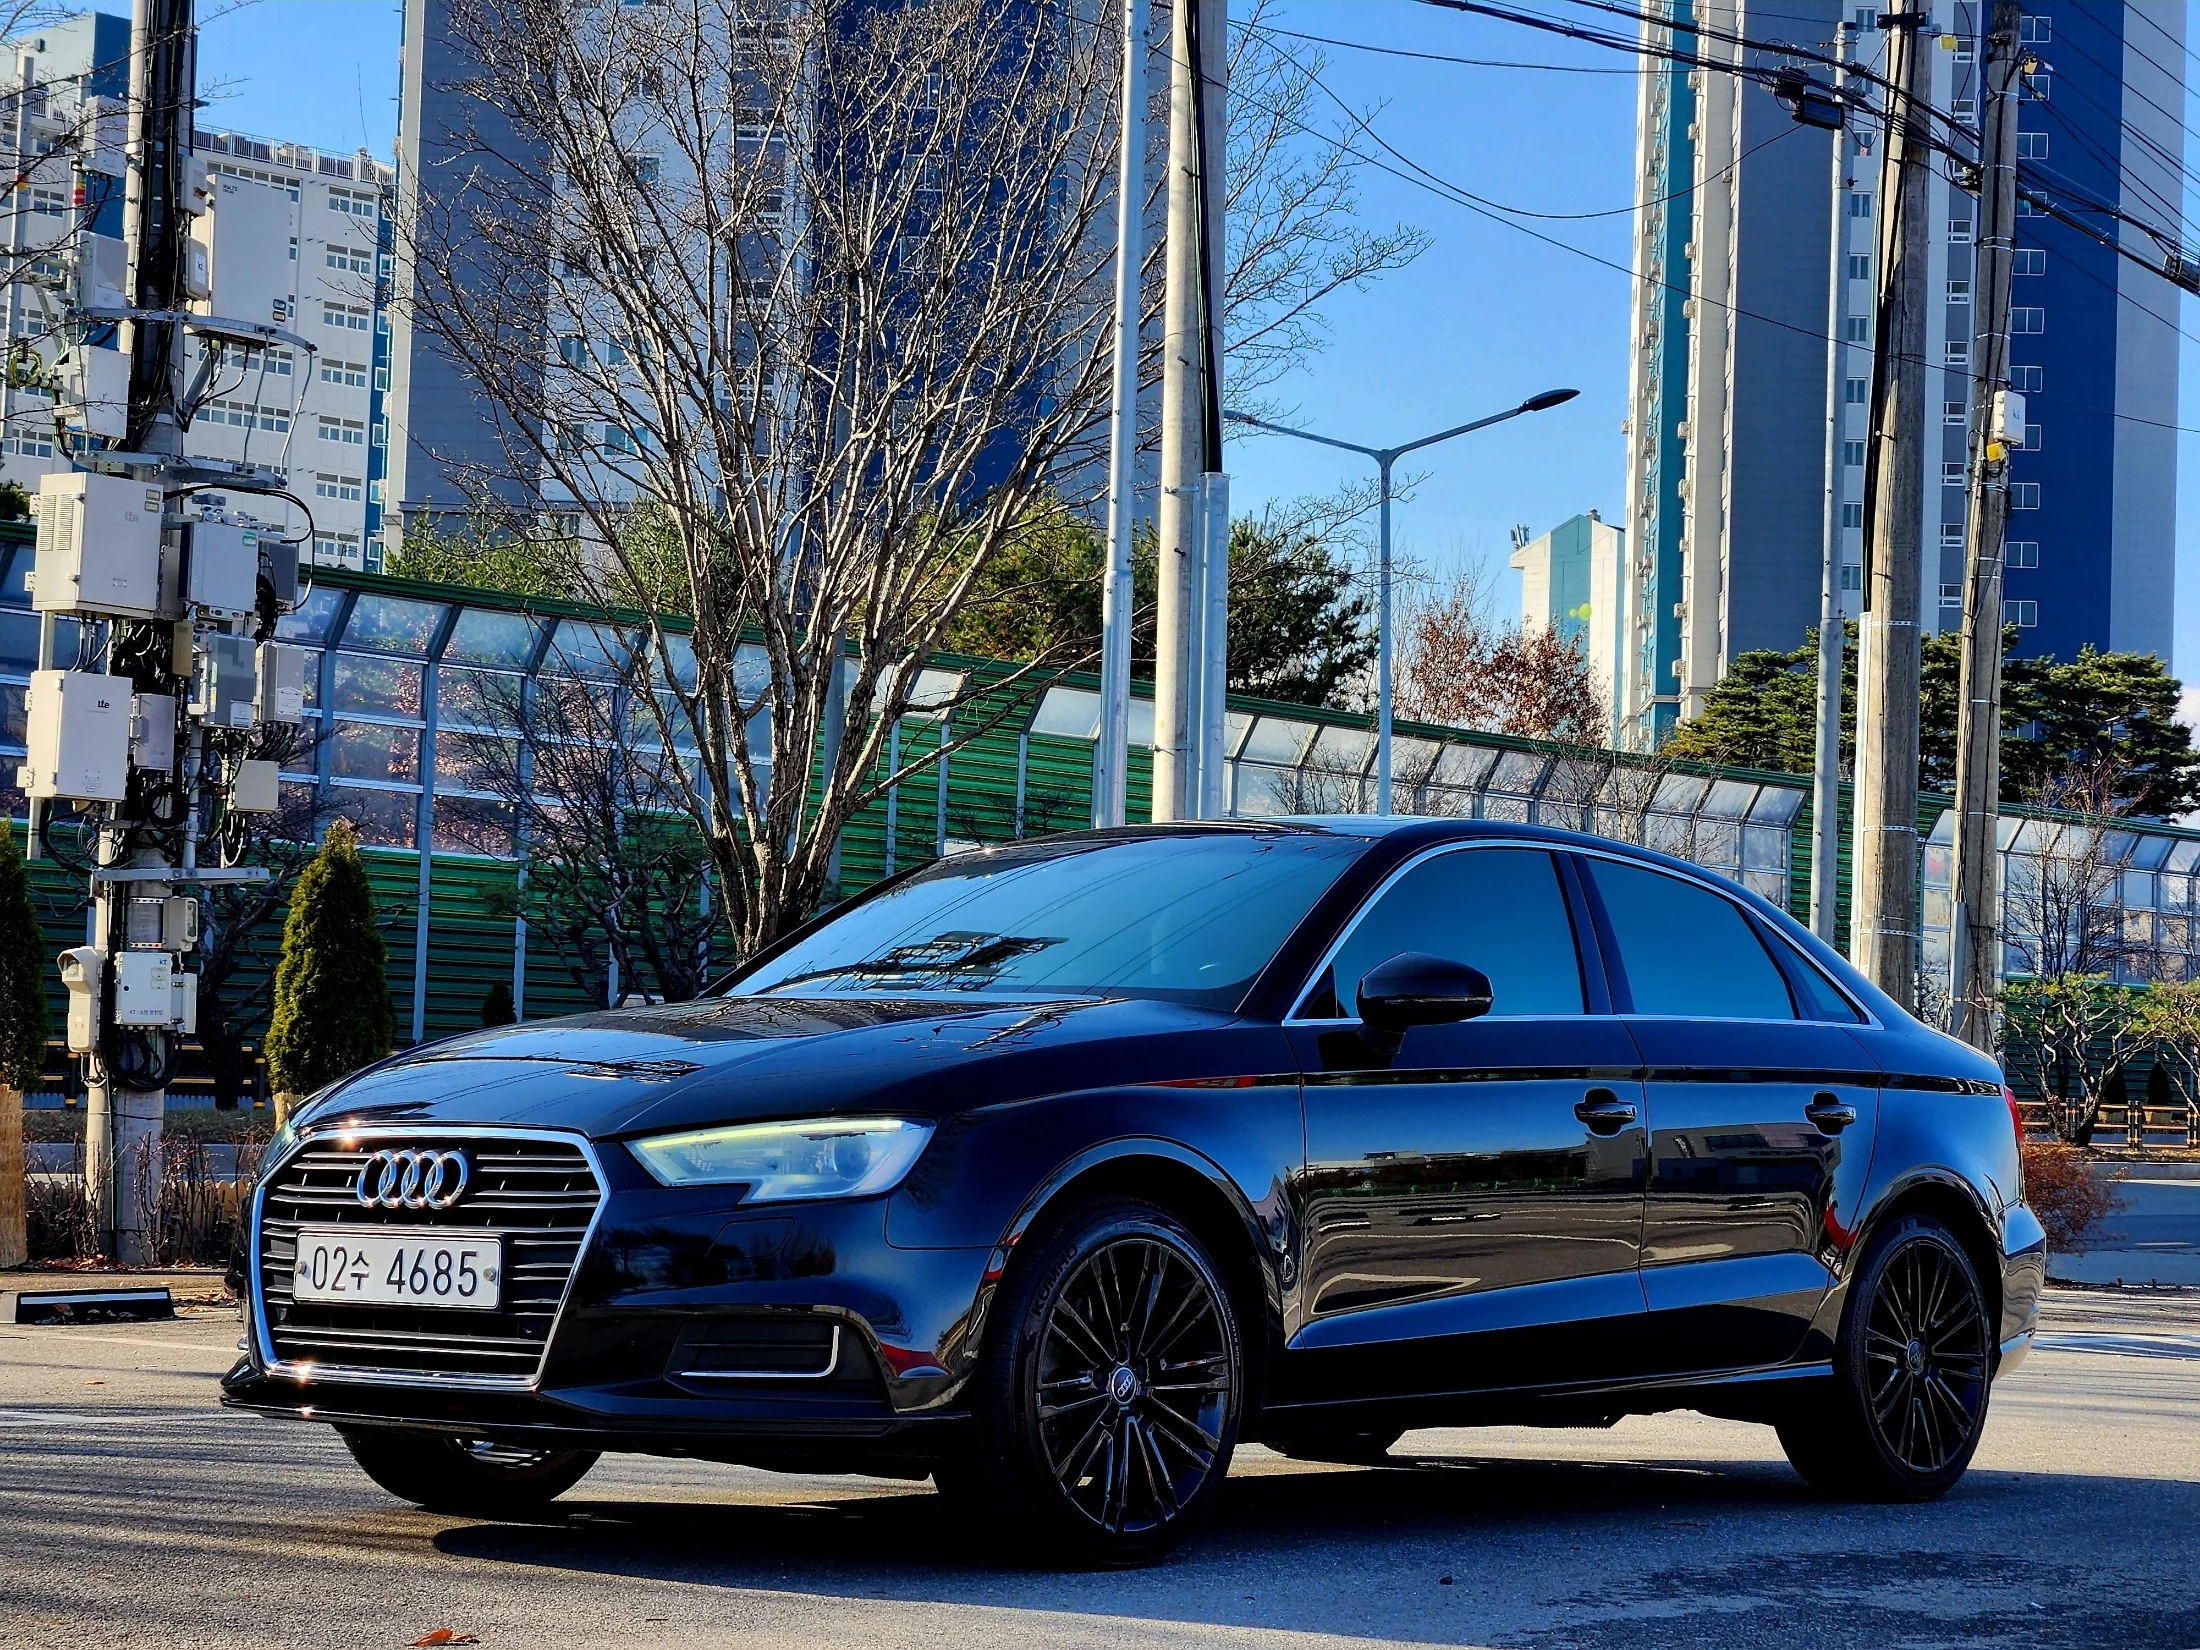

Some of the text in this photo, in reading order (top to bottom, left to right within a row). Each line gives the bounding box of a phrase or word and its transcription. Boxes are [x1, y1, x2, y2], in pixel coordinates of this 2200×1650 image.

[312, 1244, 478, 1298] 02수 4685
[1031, 1243, 1080, 1317] KUMHO
